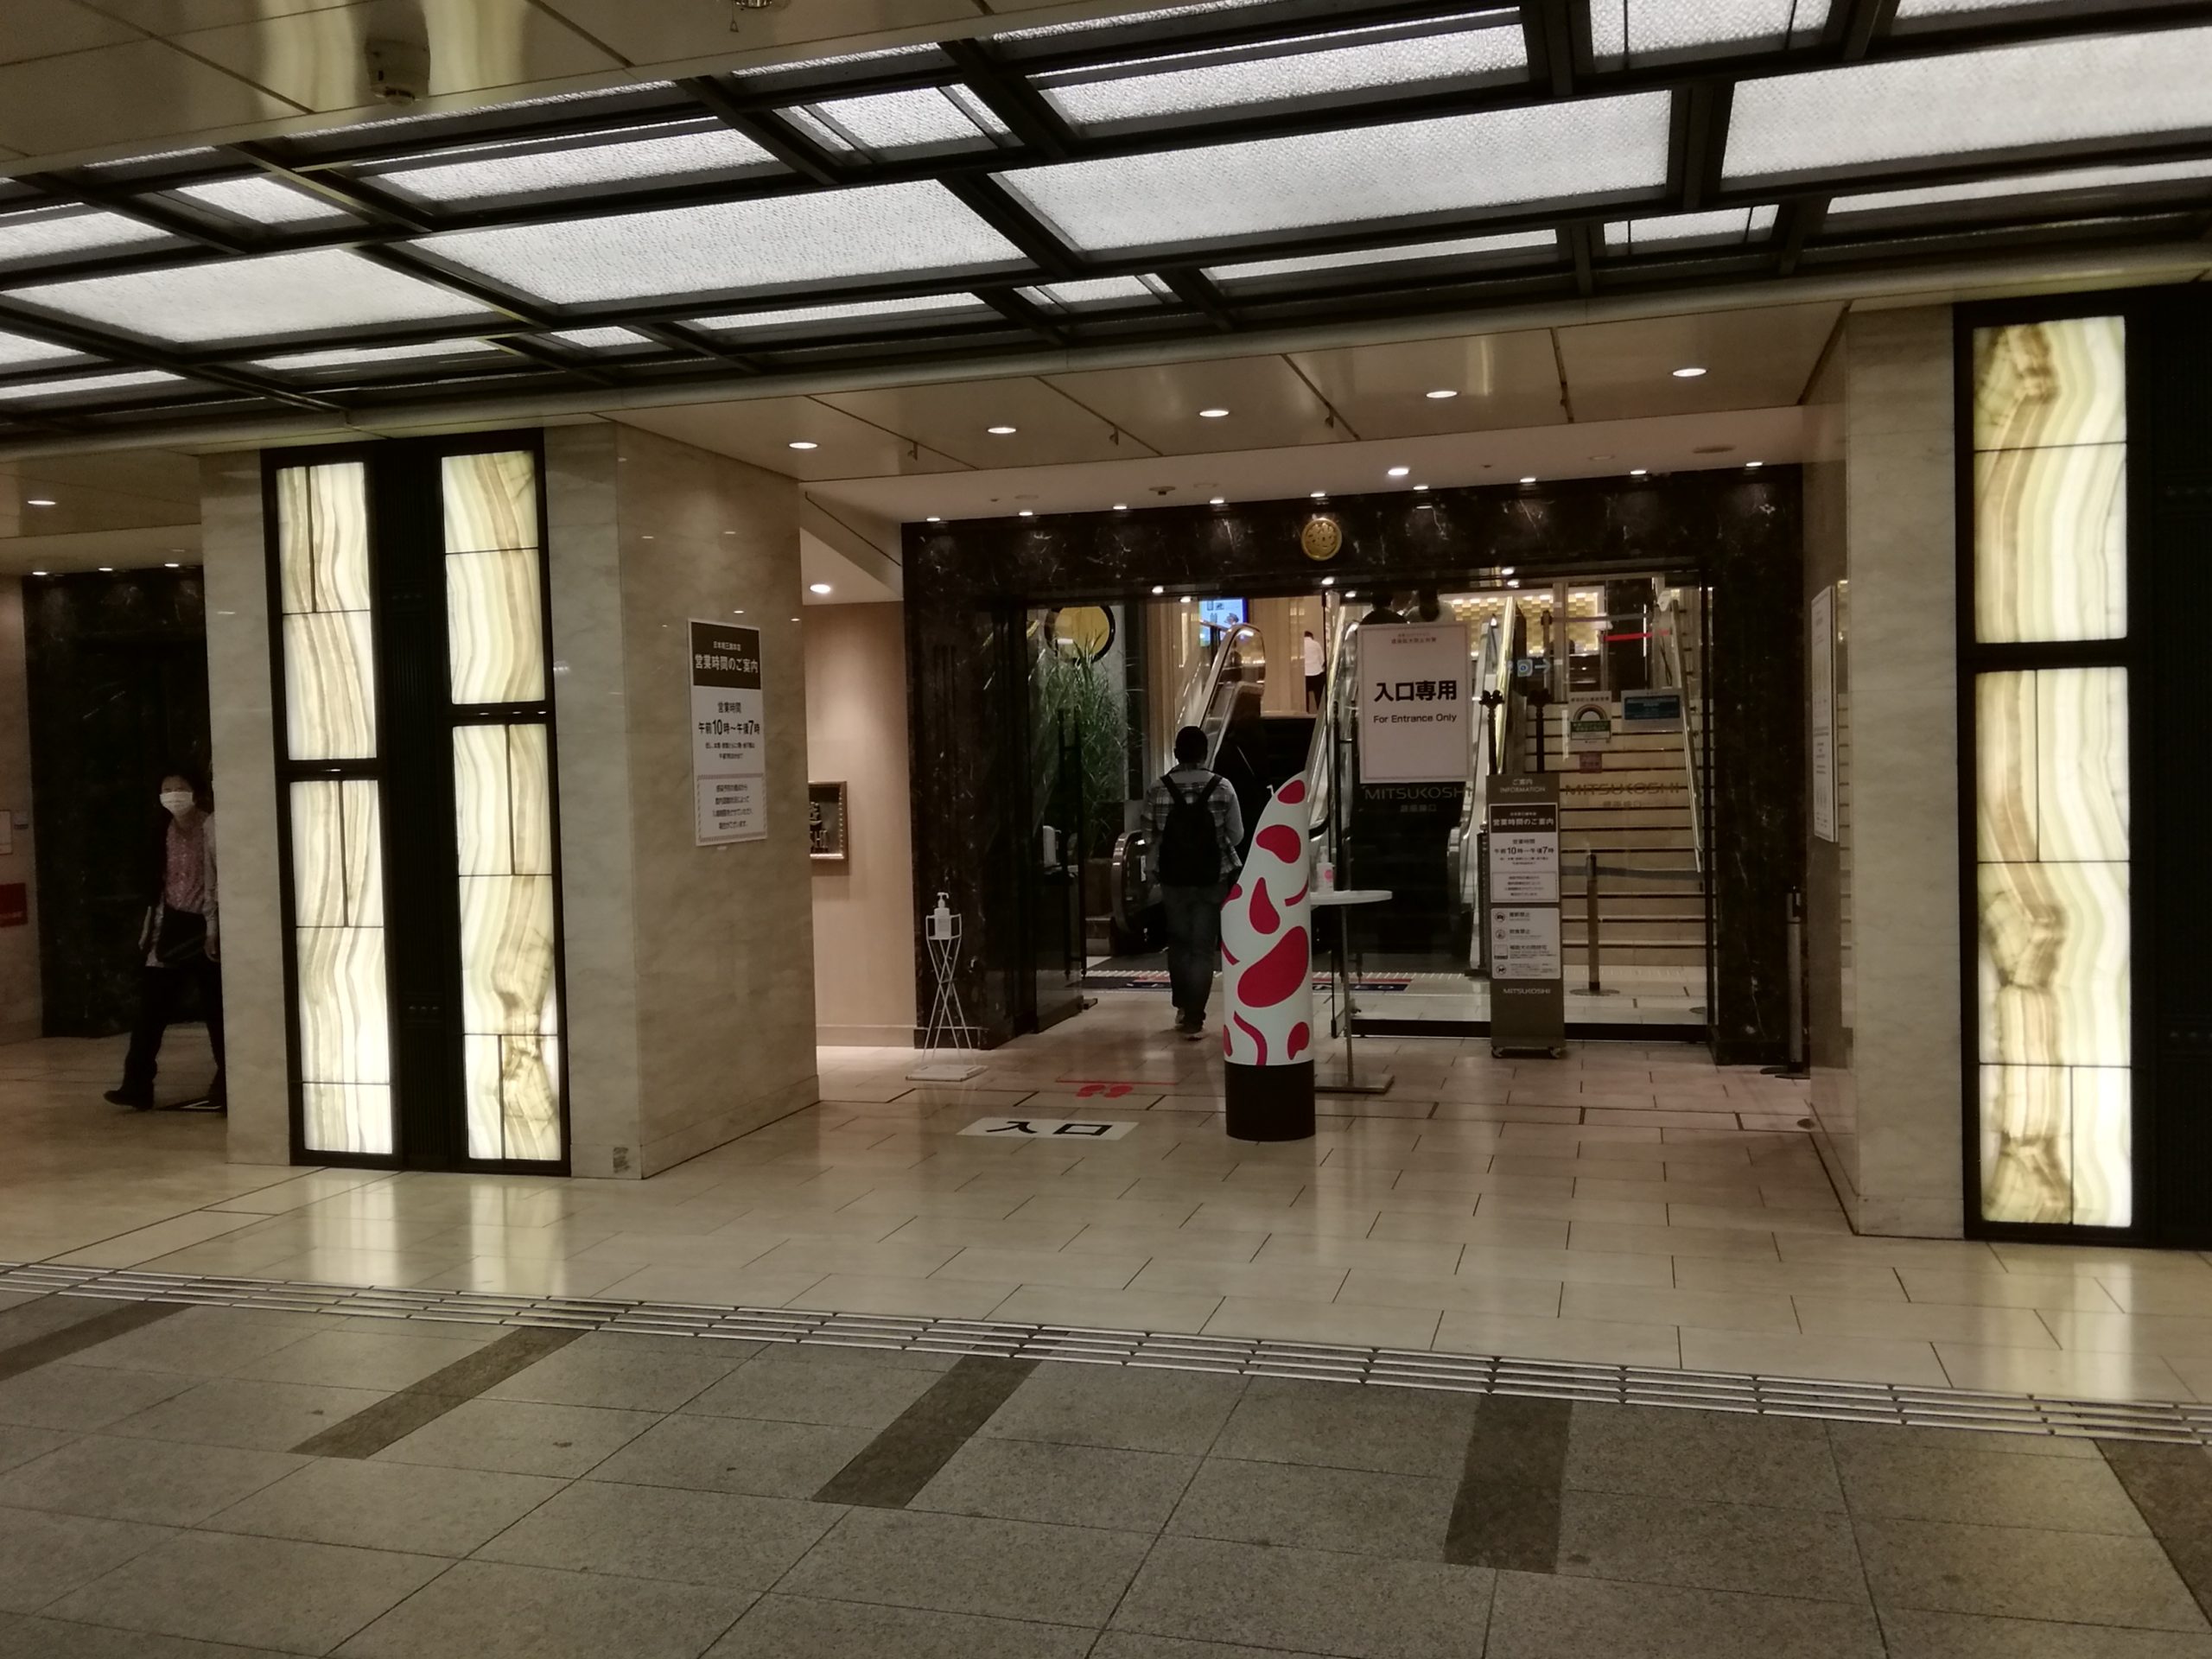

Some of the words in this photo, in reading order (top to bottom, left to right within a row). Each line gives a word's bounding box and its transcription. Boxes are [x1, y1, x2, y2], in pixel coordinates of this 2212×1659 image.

[694, 653, 759, 674] 営業時間のご案内
[1374, 680, 1457, 702] 入口専用
[717, 702, 742, 714] 営業時間
[1373, 715, 1389, 724] For
[1391, 714, 1433, 723] Entrance
[1436, 713, 1458, 723] Only
[1566, 782, 1679, 795] MITSUKOSHI
[1492, 817, 1554, 827] 営業時間のご案内
[986, 1121, 1113, 1136] 入口
